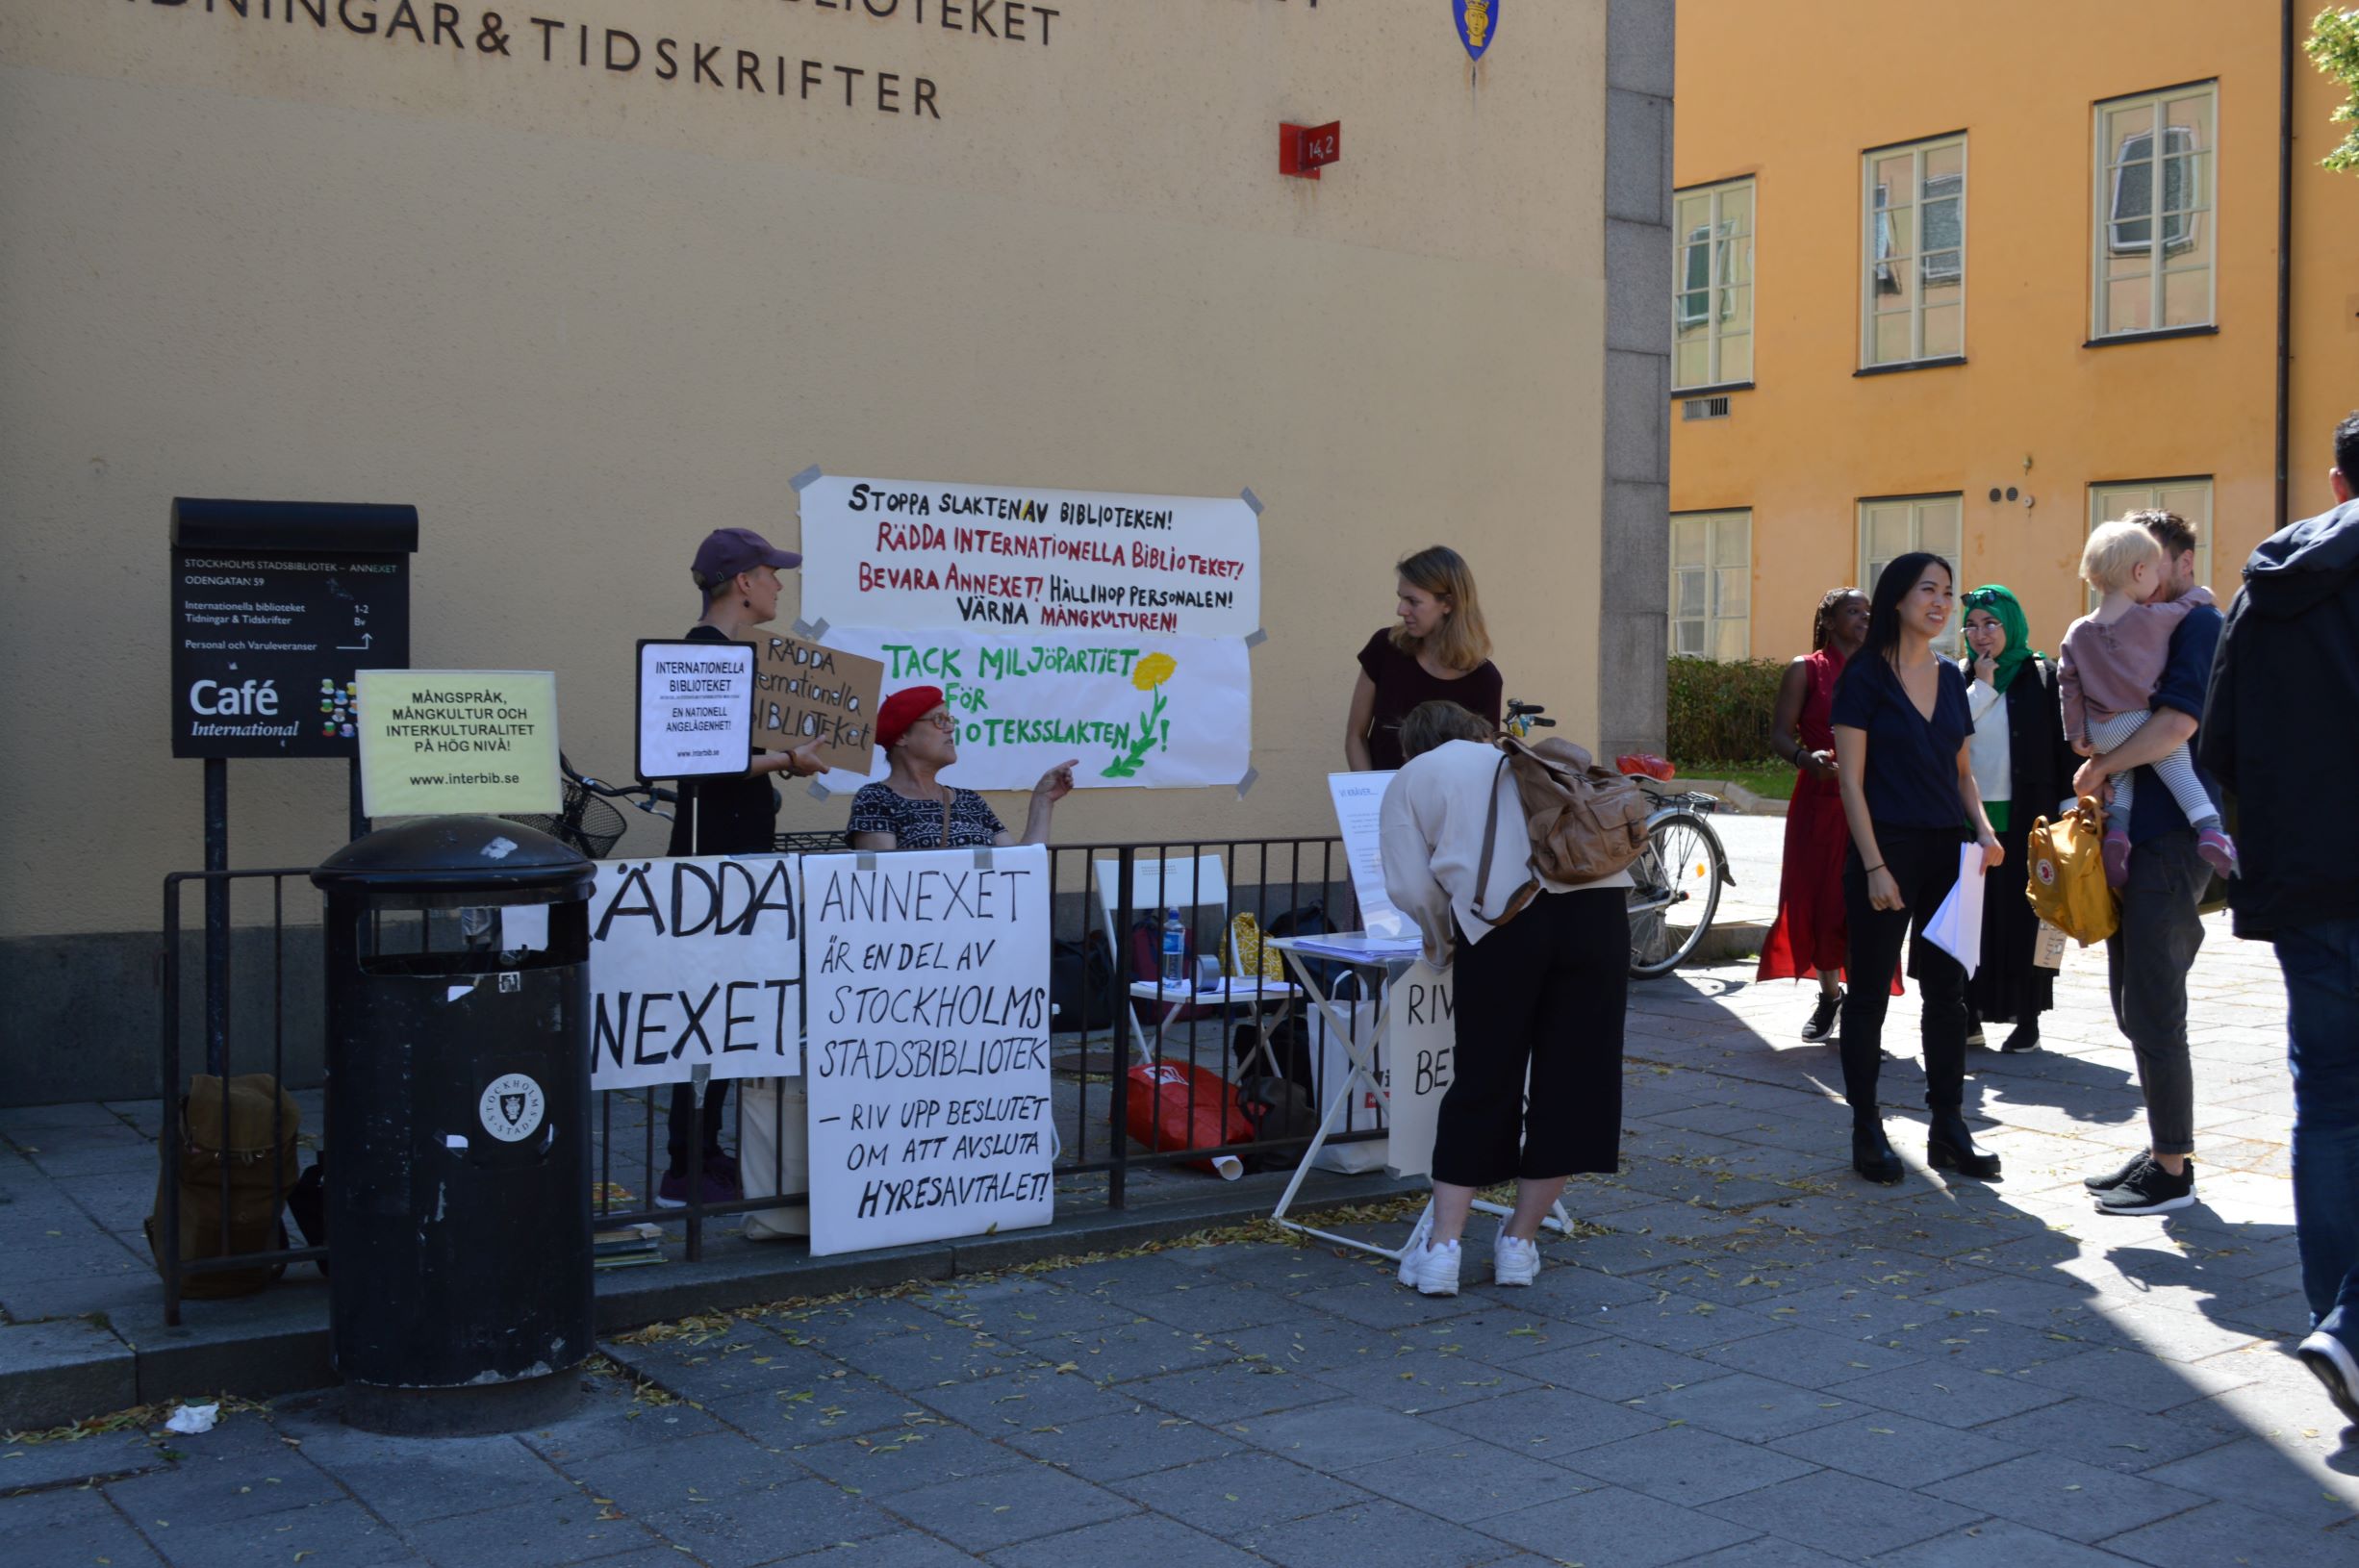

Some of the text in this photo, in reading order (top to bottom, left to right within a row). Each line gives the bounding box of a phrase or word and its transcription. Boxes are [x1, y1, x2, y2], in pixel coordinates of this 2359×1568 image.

[475, 13, 511, 56] &
[531, 17, 941, 119] TIDSKRIFTER
[849, 483, 930, 516] STOPPA
[938, 493, 1022, 520] SLAKTEN
[1060, 502, 1173, 530] BIBLIOTEKEN!
[185, 559, 255, 569] STOCKHOLMS
[258, 561, 337, 571] STADSBIBLIOTEK
[349, 564, 396, 573] ANNEXET
[876, 521, 1244, 580] RÄDDA INTERNATIONELLA BIBLIOTEKET!
[185, 576, 265, 587] ODENGATAN 59
[859, 561, 940, 592] BEVARA
[945, 562, 1044, 602] ANNEXET!
[1130, 586, 1232, 609] PERSONALEN!
[185, 600, 369, 615] Internationella biblioteket 1-2
[186, 613, 229, 625] Tidningar
[232, 615, 240, 624] &
[241, 614, 292, 625] Tidskrifter
[956, 594, 1177, 633] VÄRNA MÅNGKULTUREN!
[185, 639, 317, 651] Personal och Varuleveranser
[768, 638, 835, 674] RÄDDA
[881, 645, 1140, 680] TACK MILJÖPARTIET
[655, 661, 745, 674] INTERNATIONELLA
[190, 679, 279, 716] Café
[412, 689, 507, 704] MÅNGSPRÅK,
[670, 679, 732, 693] BIBLIOTEKET
[755, 670, 862, 717] ernationella
[944, 682, 988, 714] FÖR
[190, 721, 299, 737] International
[393, 706, 527, 721] MÅNGKULTUR OCH
[672, 706, 728, 718] EN NATIONELL
[753, 698, 871, 750] IBLIOTEKet
[387, 724, 535, 737] INTERKULTURALITET
[415, 738, 511, 752] PÅ HÖG NIVÅ!
[953, 719, 1130, 750] IOTEKSSLAKTEN
[410, 772, 520, 785] www.interbib.se
[590, 860, 797, 942] ÄDDA
[821, 871, 1030, 923] ANNEXET
[821, 935, 854, 974] ÄR
[956, 939, 996, 971] AV
[829, 985, 1045, 1028] STOCKHOLMS
[590, 978, 800, 1074] NEXET
[820, 1037, 1048, 1079] STADSBIBLIOTEK
[1415, 1047, 1455, 1096] BE
[486, 1079, 539, 1122] STOCKHOLMS
[850, 1103, 890, 1130] RIV
[900, 1100, 940, 1128] UPP
[947, 1096, 1050, 1125] BESLUTET
[497, 1122, 529, 1135] STAD
[848, 1131, 1039, 1171] OM ATT AVSLUTA
[857, 1173, 1051, 1219] HYRESAVTALET!
